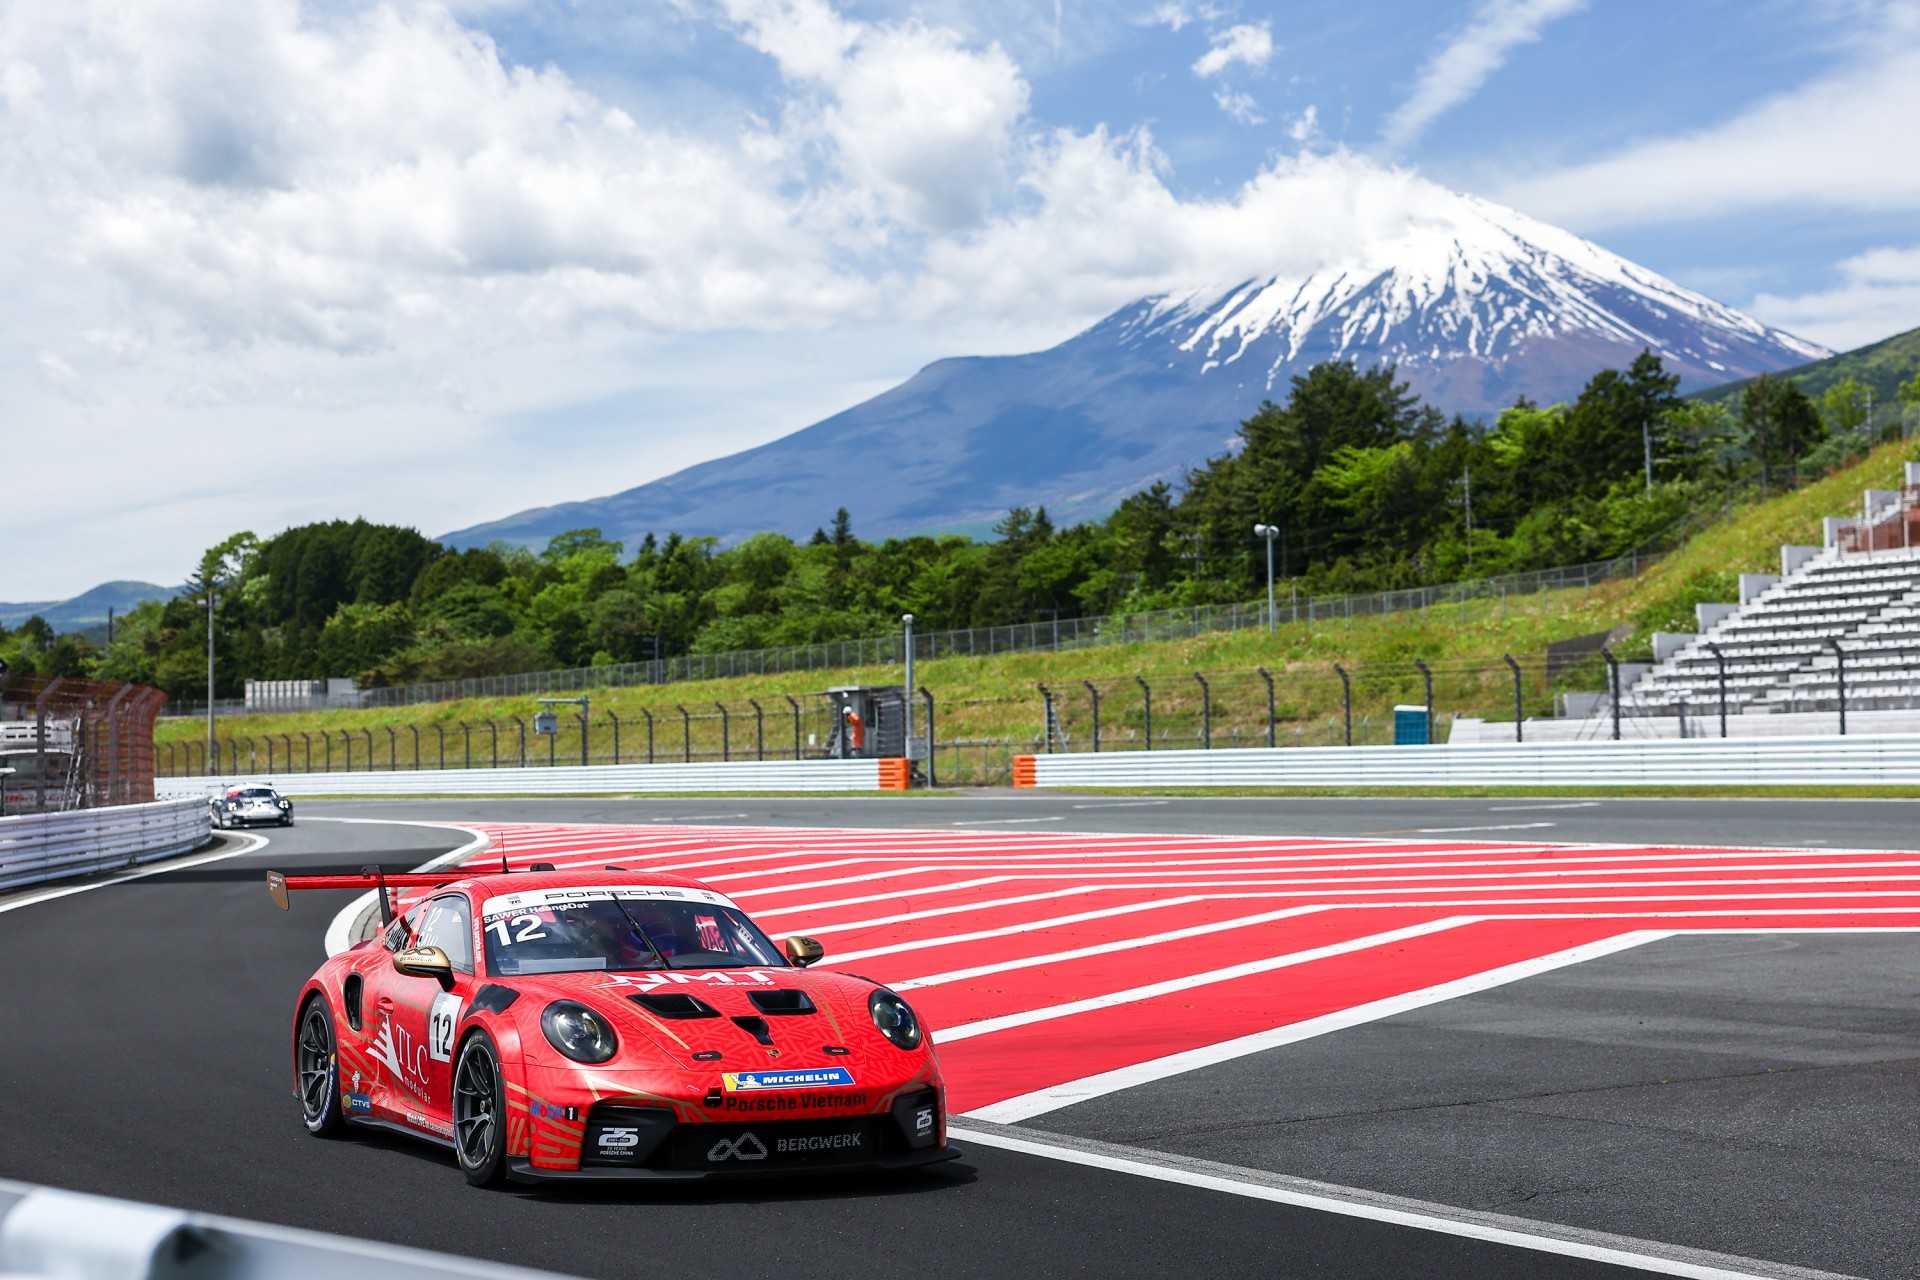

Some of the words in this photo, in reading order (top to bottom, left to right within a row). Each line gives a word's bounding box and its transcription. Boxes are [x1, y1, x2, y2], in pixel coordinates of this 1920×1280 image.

[545, 889, 685, 900] PORSCHE
[484, 908, 528, 924] SAWER
[529, 904, 567, 914] Hoang
[566, 902, 590, 910] Dat
[484, 914, 547, 947] 12
[604, 970, 776, 986] NMT
[433, 1012, 452, 1056] 12
[395, 1023, 430, 1085] TLC
[762, 1072, 840, 1084] MICHELIN
[404, 1076, 431, 1105] modular
[352, 1099, 371, 1109] CTVS
[530, 1100, 563, 1120] Mobil
[726, 1094, 797, 1112] Porsche
[800, 1092, 867, 1109] Vietnam
[777, 1131, 862, 1152] BERGWERK
